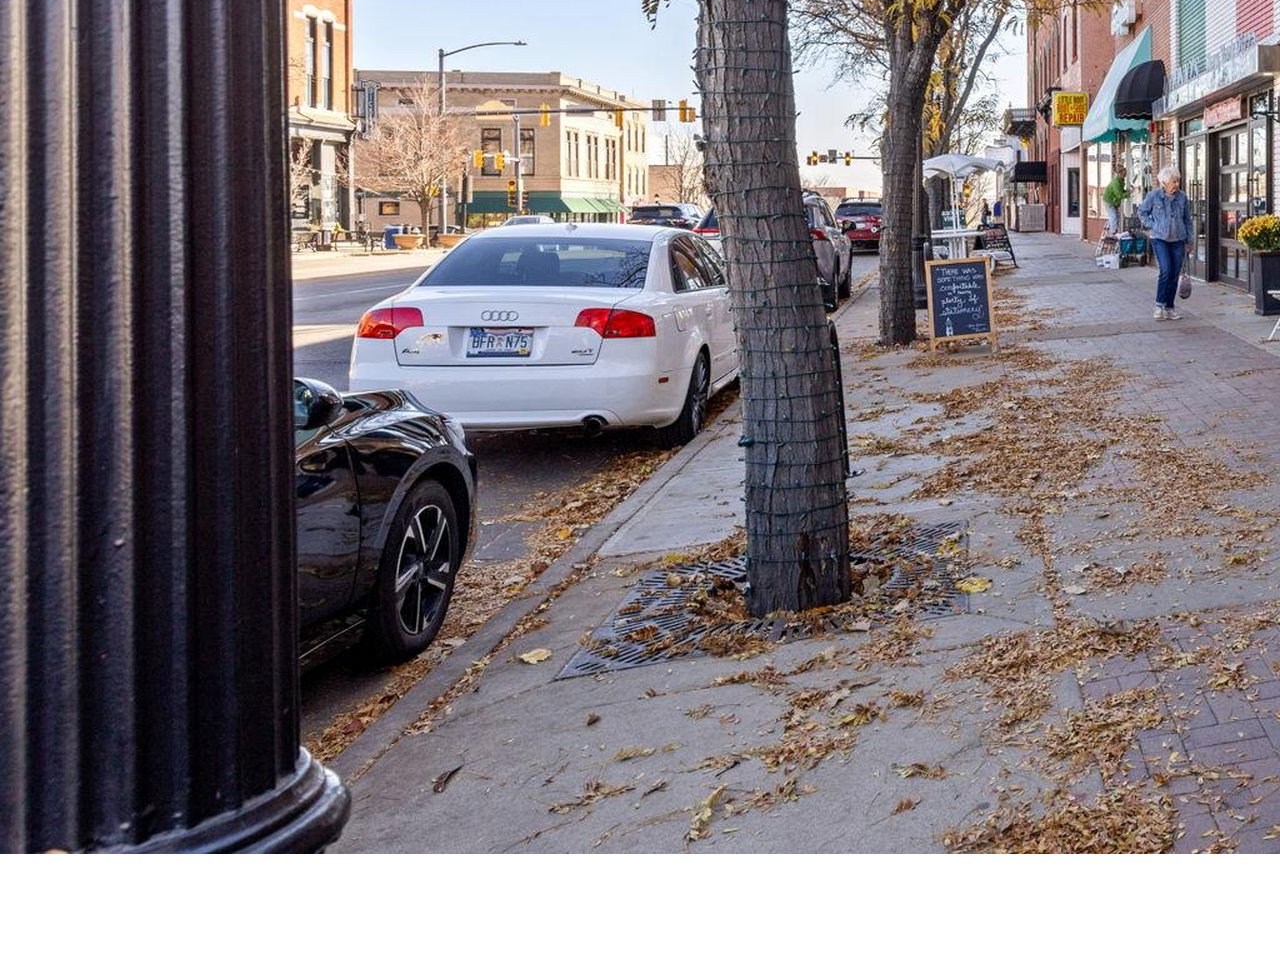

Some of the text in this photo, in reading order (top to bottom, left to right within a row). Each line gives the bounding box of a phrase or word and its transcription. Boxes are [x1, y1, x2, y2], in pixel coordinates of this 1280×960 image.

[1059, 113, 1084, 123] REPAIR
[472, 335, 528, 348] BFR N75
